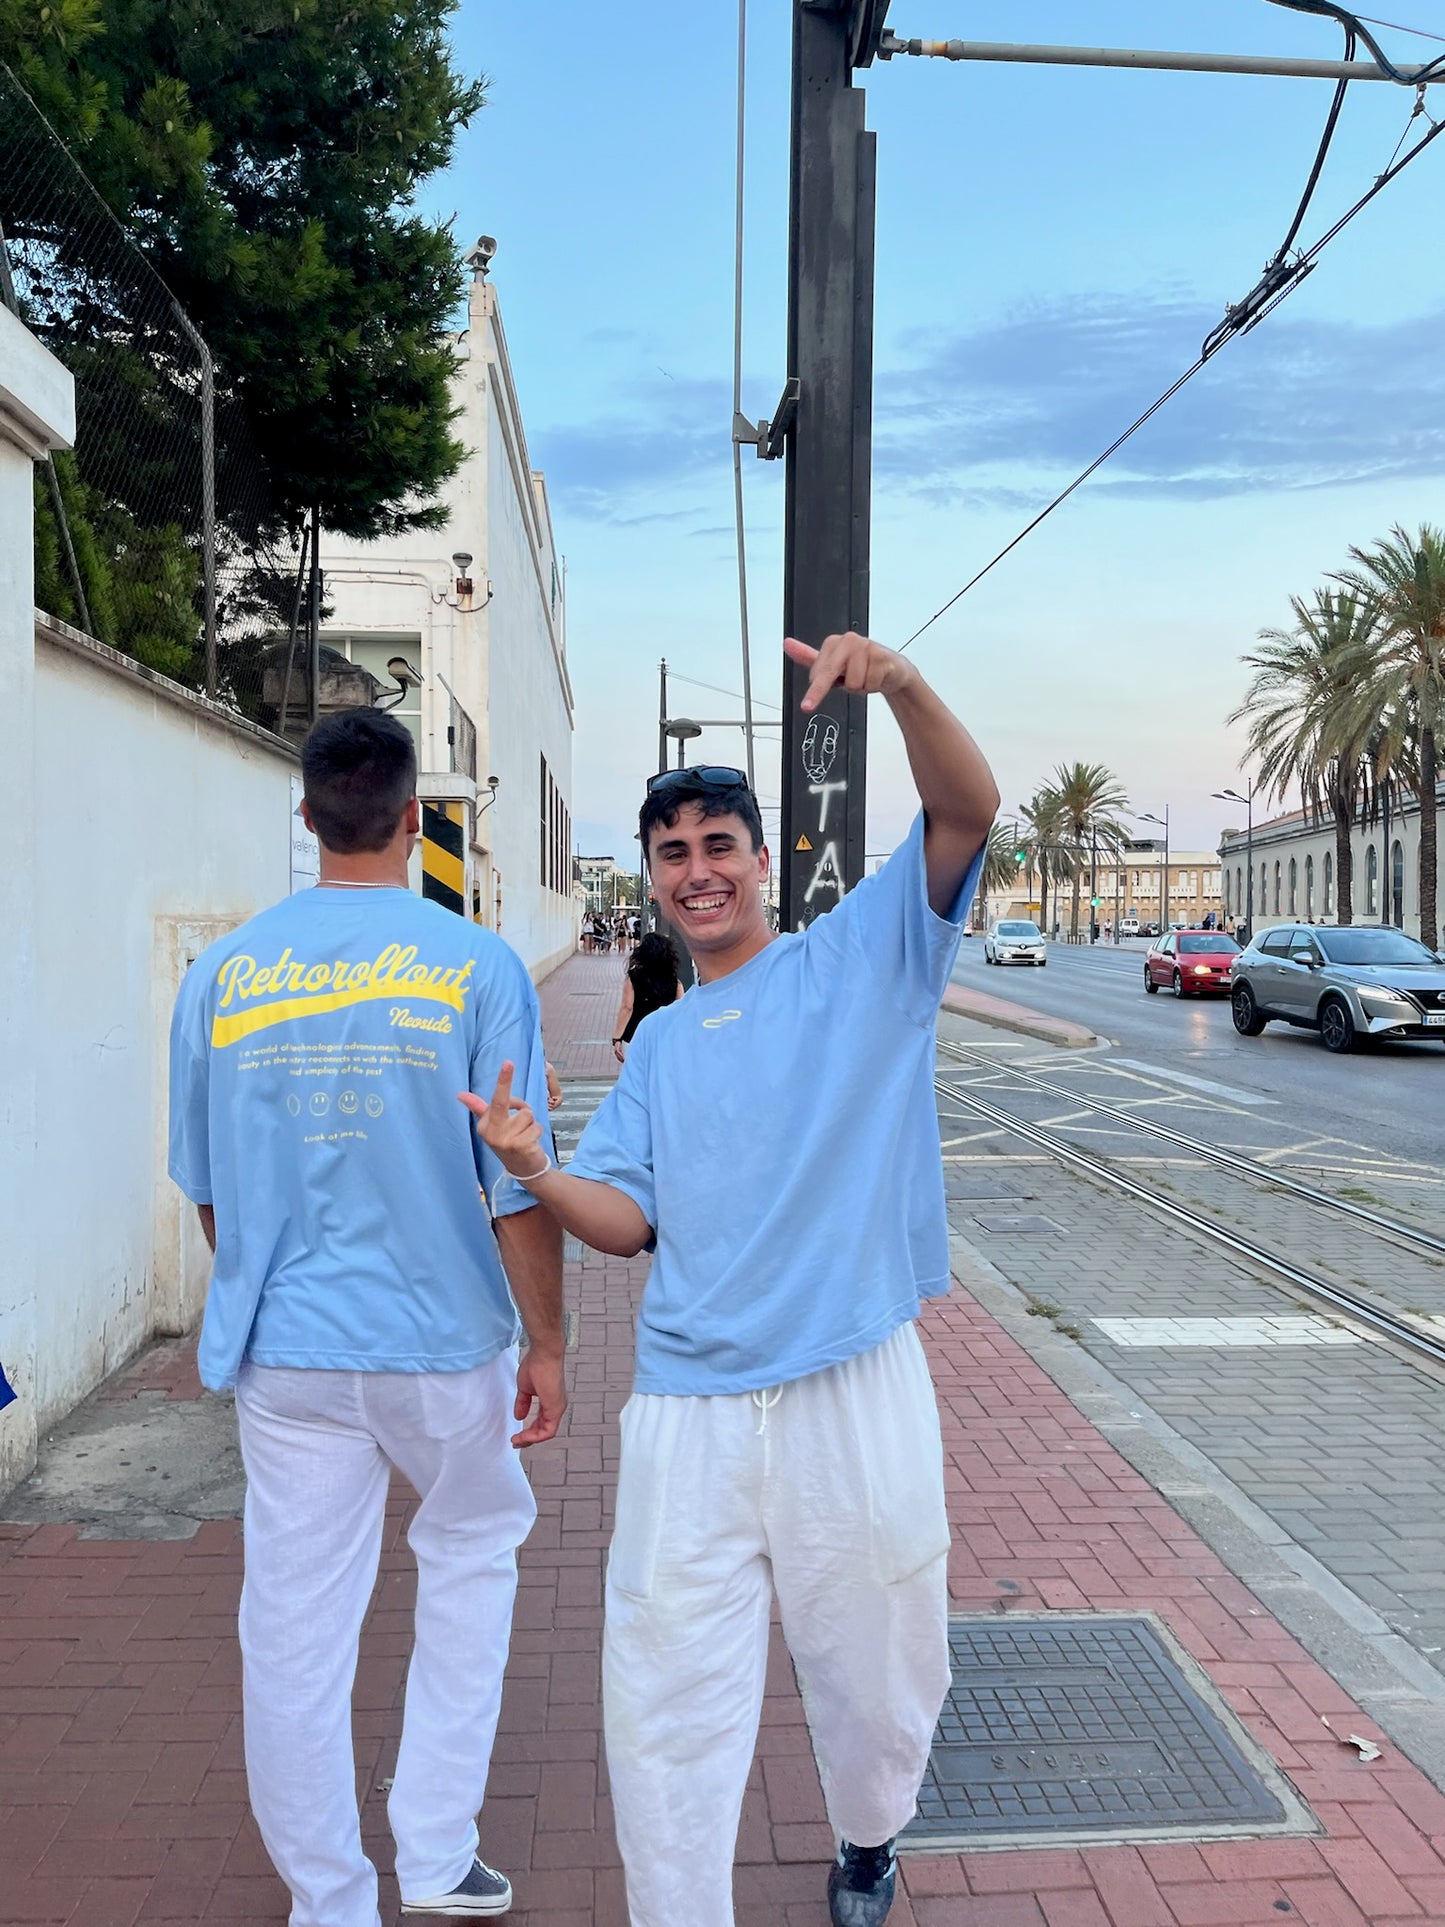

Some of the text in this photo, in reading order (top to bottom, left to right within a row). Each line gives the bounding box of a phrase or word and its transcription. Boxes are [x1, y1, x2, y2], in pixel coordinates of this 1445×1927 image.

[293, 839, 319, 855] valenc
[218, 943, 477, 1007] Retrorollout
[389, 1007, 453, 1034] Neoside
[405, 1044, 436, 1059] finding
